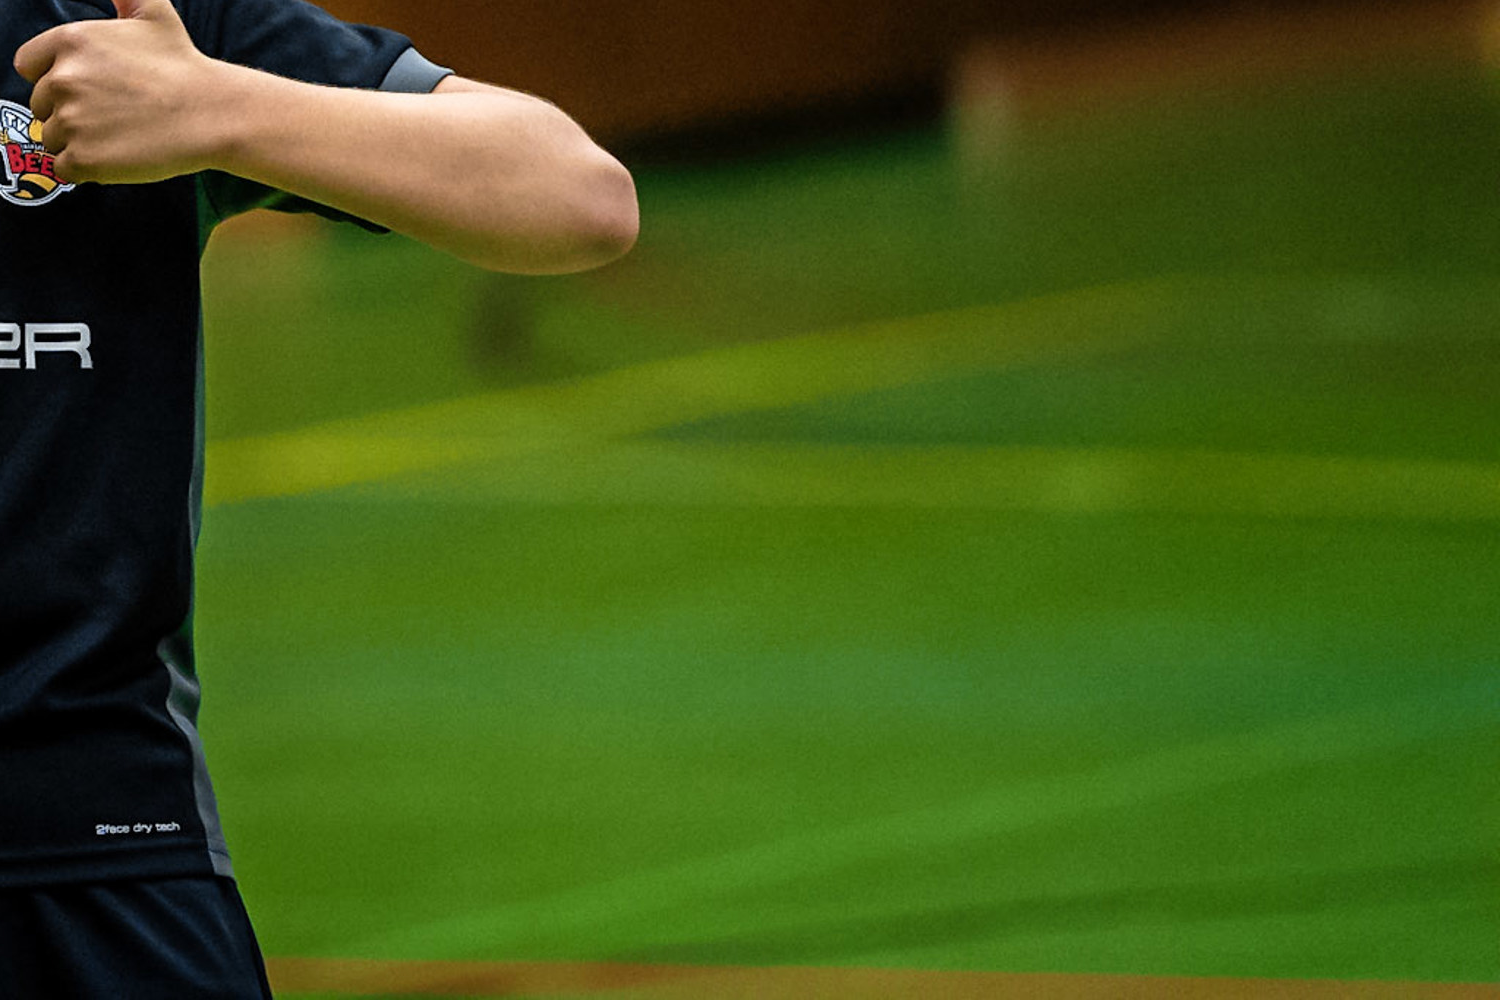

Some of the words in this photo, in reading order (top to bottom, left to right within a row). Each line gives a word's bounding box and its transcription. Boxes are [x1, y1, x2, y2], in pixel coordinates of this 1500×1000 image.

[5, 143, 63, 182] BEE
[95, 824, 130, 835] 2face
[132, 822, 153, 834] dry
[155, 821, 181, 831] tech
